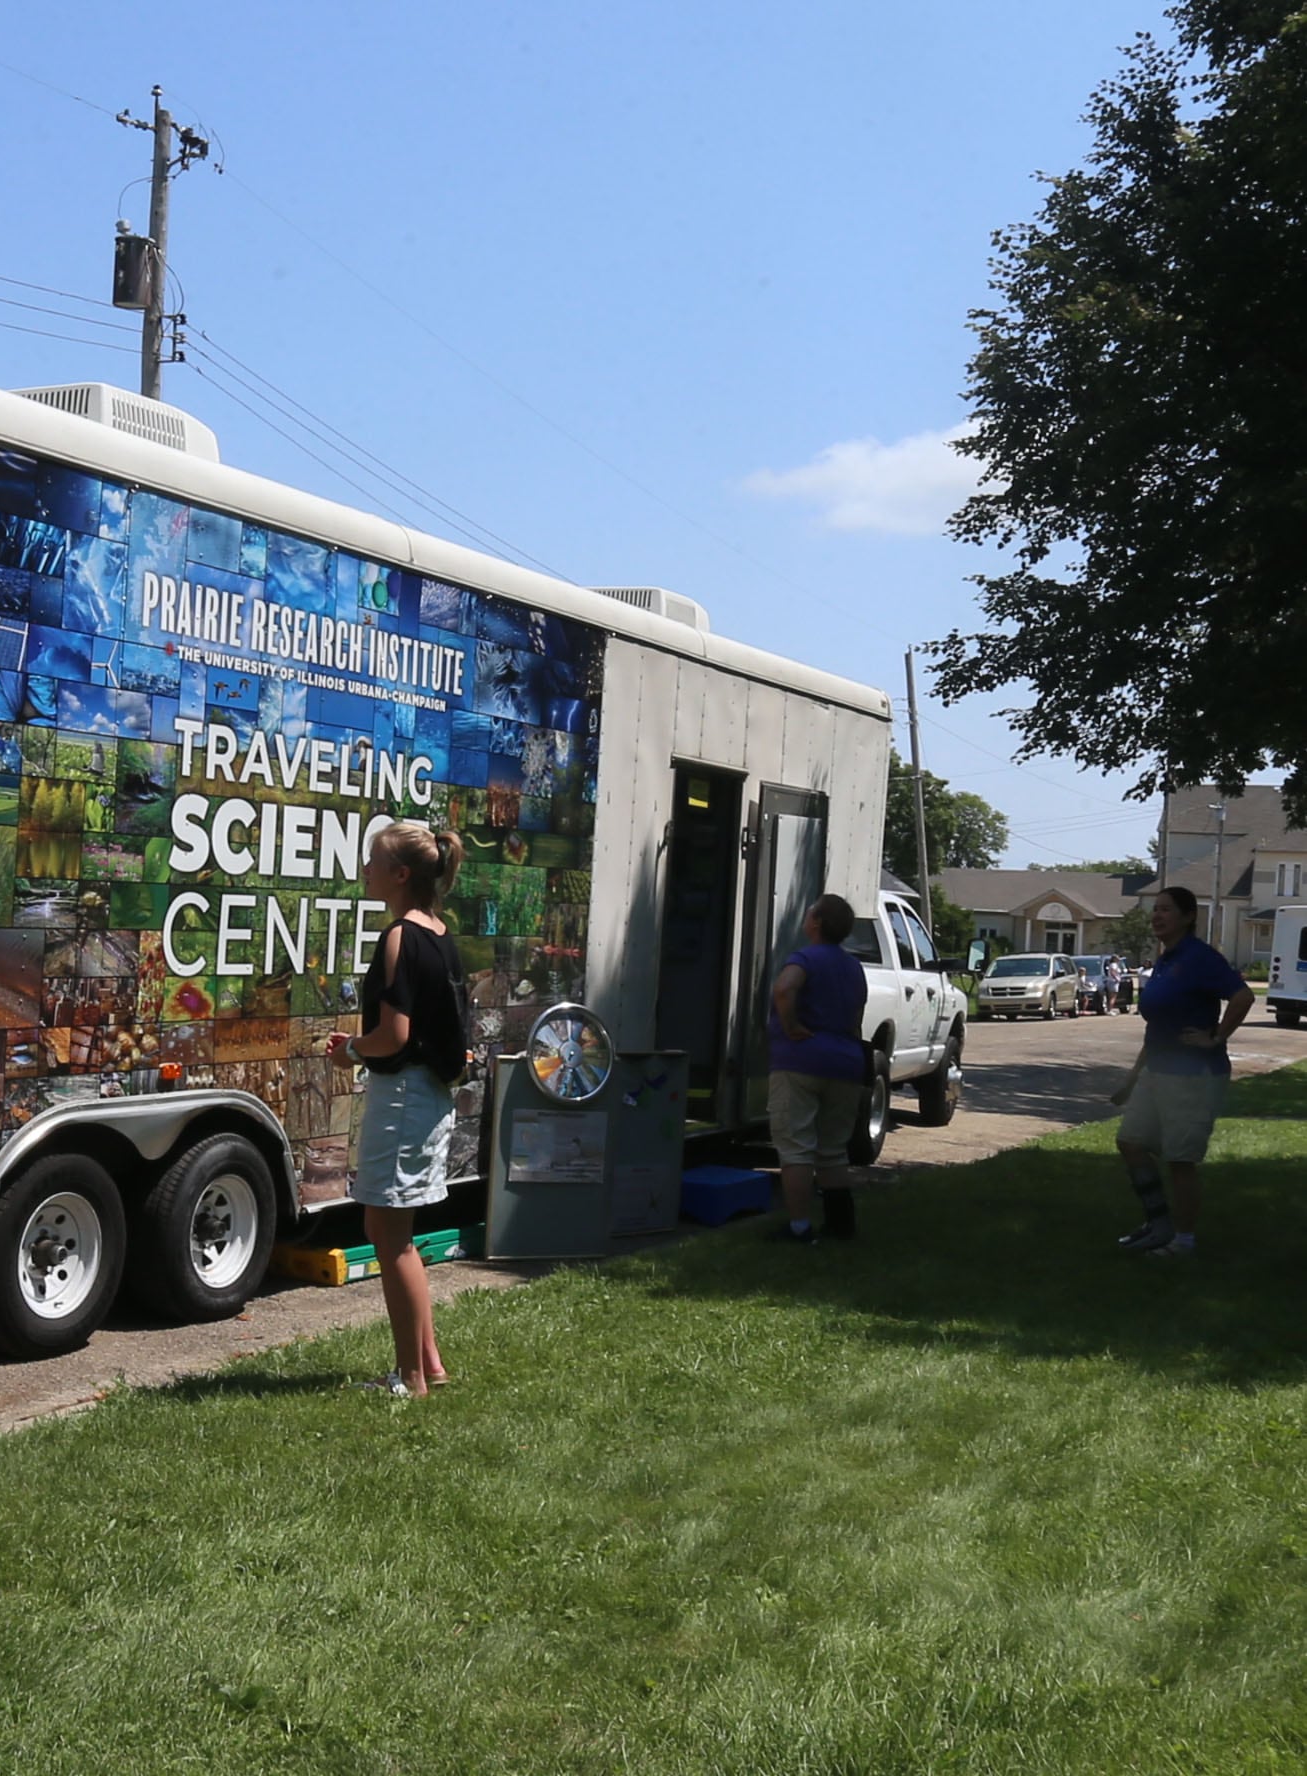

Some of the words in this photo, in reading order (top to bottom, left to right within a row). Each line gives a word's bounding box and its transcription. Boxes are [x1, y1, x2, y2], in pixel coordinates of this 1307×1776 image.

[142, 572, 244, 648] PRAIRIE
[251, 598, 363, 674] RESEARCH
[368, 628, 465, 696] INSTITUTE
[178, 645, 201, 662] THE
[204, 651, 278, 677] UNIVERSITY
[280, 666, 294, 680] OF
[297, 670, 345, 691] ILLINOIS
[174, 718, 433, 806] TRAVELING
[168, 793, 429, 881] SCIENC
[162, 891, 387, 977] CENTE
